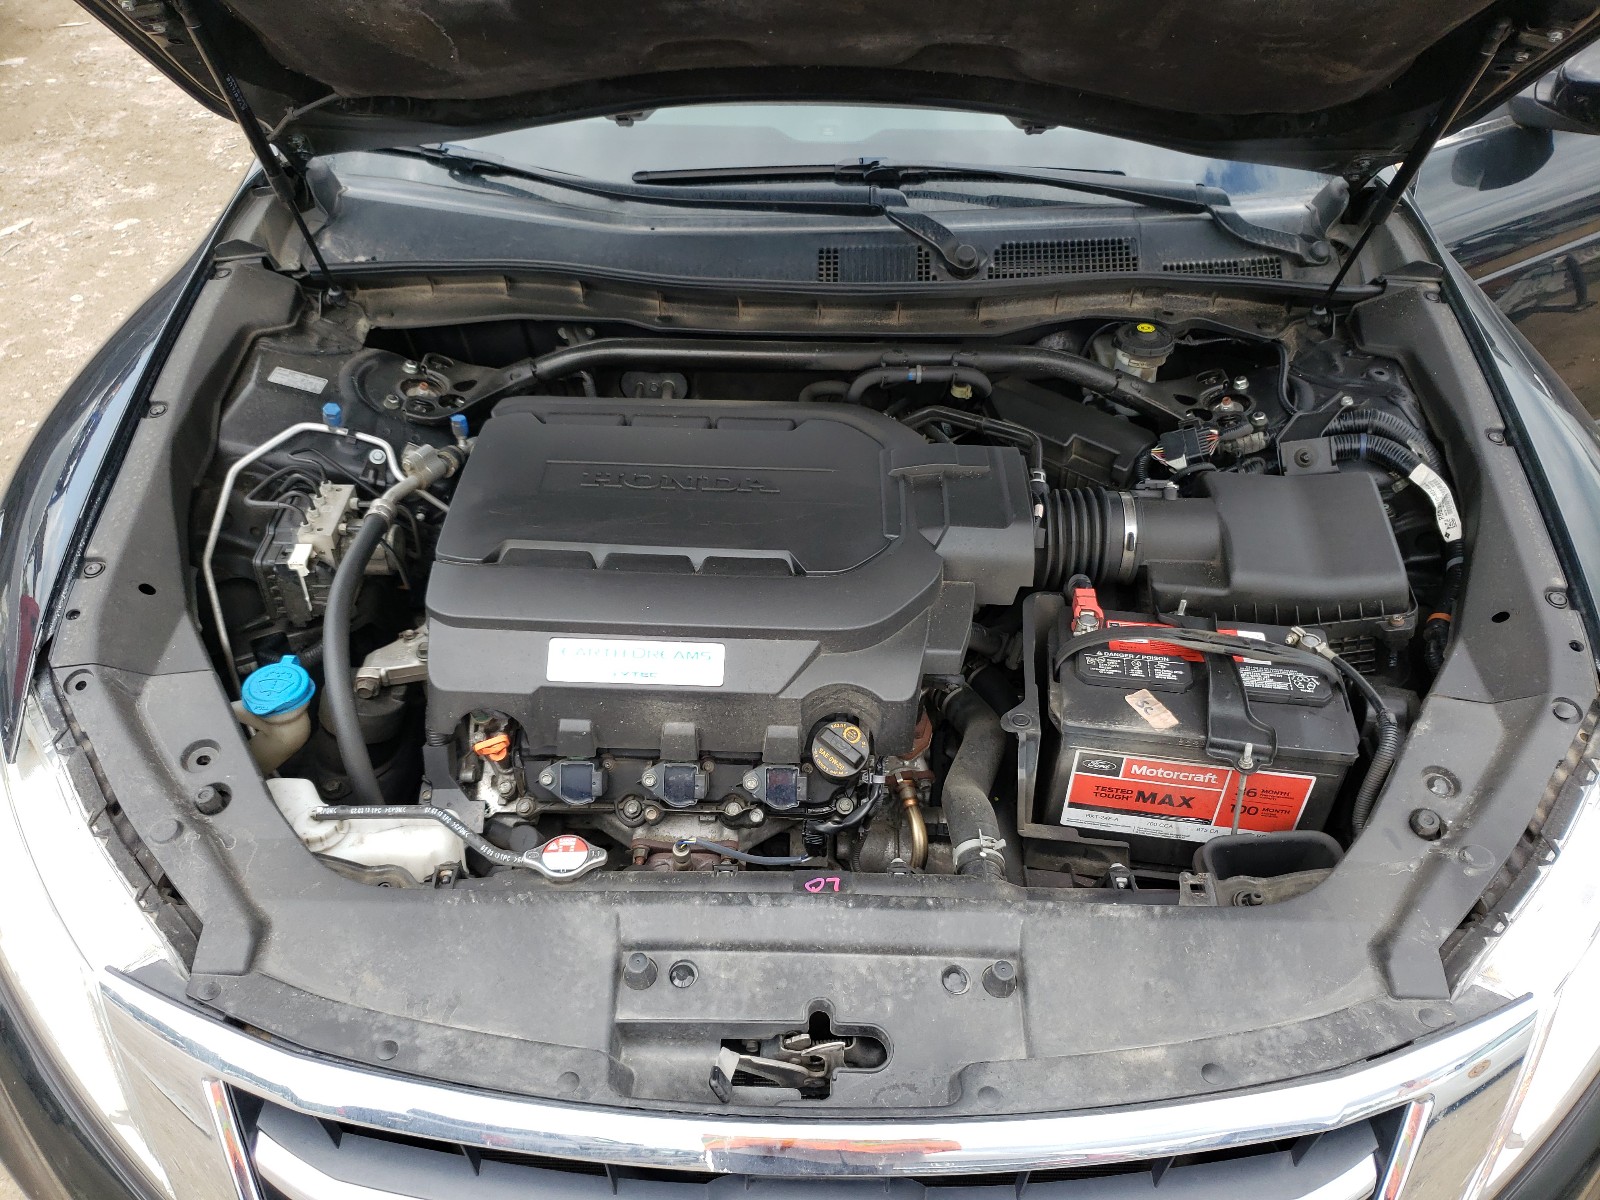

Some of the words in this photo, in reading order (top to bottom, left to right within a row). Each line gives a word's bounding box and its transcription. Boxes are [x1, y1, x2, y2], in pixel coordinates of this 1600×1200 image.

[579, 472, 782, 493] HONDA
[1103, 651, 1134, 659] DANGER
[819, 747, 830, 759] SAE
[1086, 759, 1111, 770] Ford
[1130, 764, 1218, 784] Motorcraft
[1094, 785, 1134, 795] TESTED
[1261, 788, 1290, 797] MONTH
[1135, 790, 1196, 809] MAX
[1262, 807, 1291, 815] MONTH
[804, 877, 841, 893] 07
